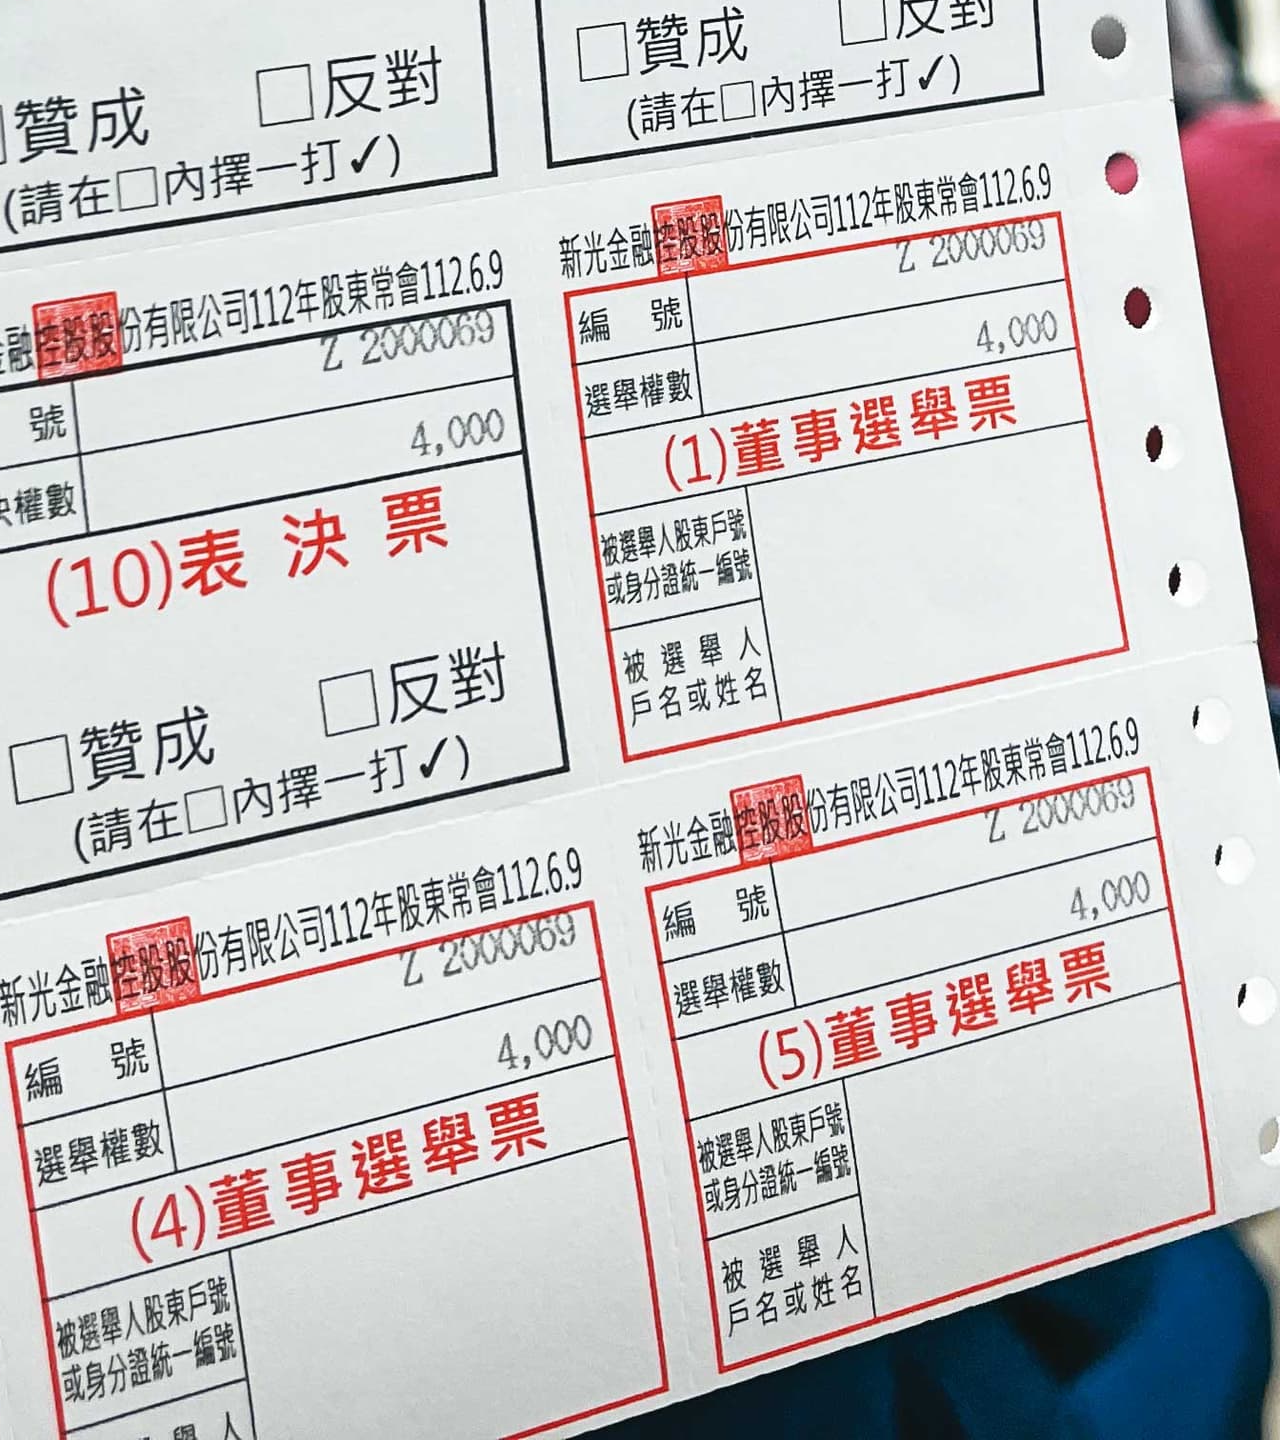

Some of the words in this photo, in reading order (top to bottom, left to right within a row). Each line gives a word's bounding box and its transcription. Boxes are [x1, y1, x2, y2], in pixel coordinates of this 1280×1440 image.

[636, 6, 748, 75] 贊成
[325, 46, 442, 119] 反對
[15, 87, 149, 163] 贊成
[932, 222, 1047, 268] 2000069
[361, 310, 495, 365] 2000069
[976, 310, 1058, 354] 4,000
[584, 370, 693, 418] 選舉權數
[411, 409, 505, 456] 4,000
[665, 375, 1016, 492] (1)董事選舉票
[600, 508, 748, 566] 被選舉人股東戶號
[388, 641, 506, 723] 反對
[80, 705, 216, 791] 贊成
[1021, 778, 1136, 835] 2000069
[1070, 870, 1151, 921] 4,000
[443, 913, 576, 976] 2000069
[673, 960, 784, 1019] 選舉權數
[759, 940, 1113, 1089] (5)董事選舉票
[497, 1016, 592, 1070] 4,000
[34, 1119, 163, 1186] 選舉權數
[698, 1102, 845, 1175] 被選舉人股東戶號
[131, 1092, 548, 1264] (4)董事選舉票
[57, 1276, 230, 1359] 被選舉人股東戶號
